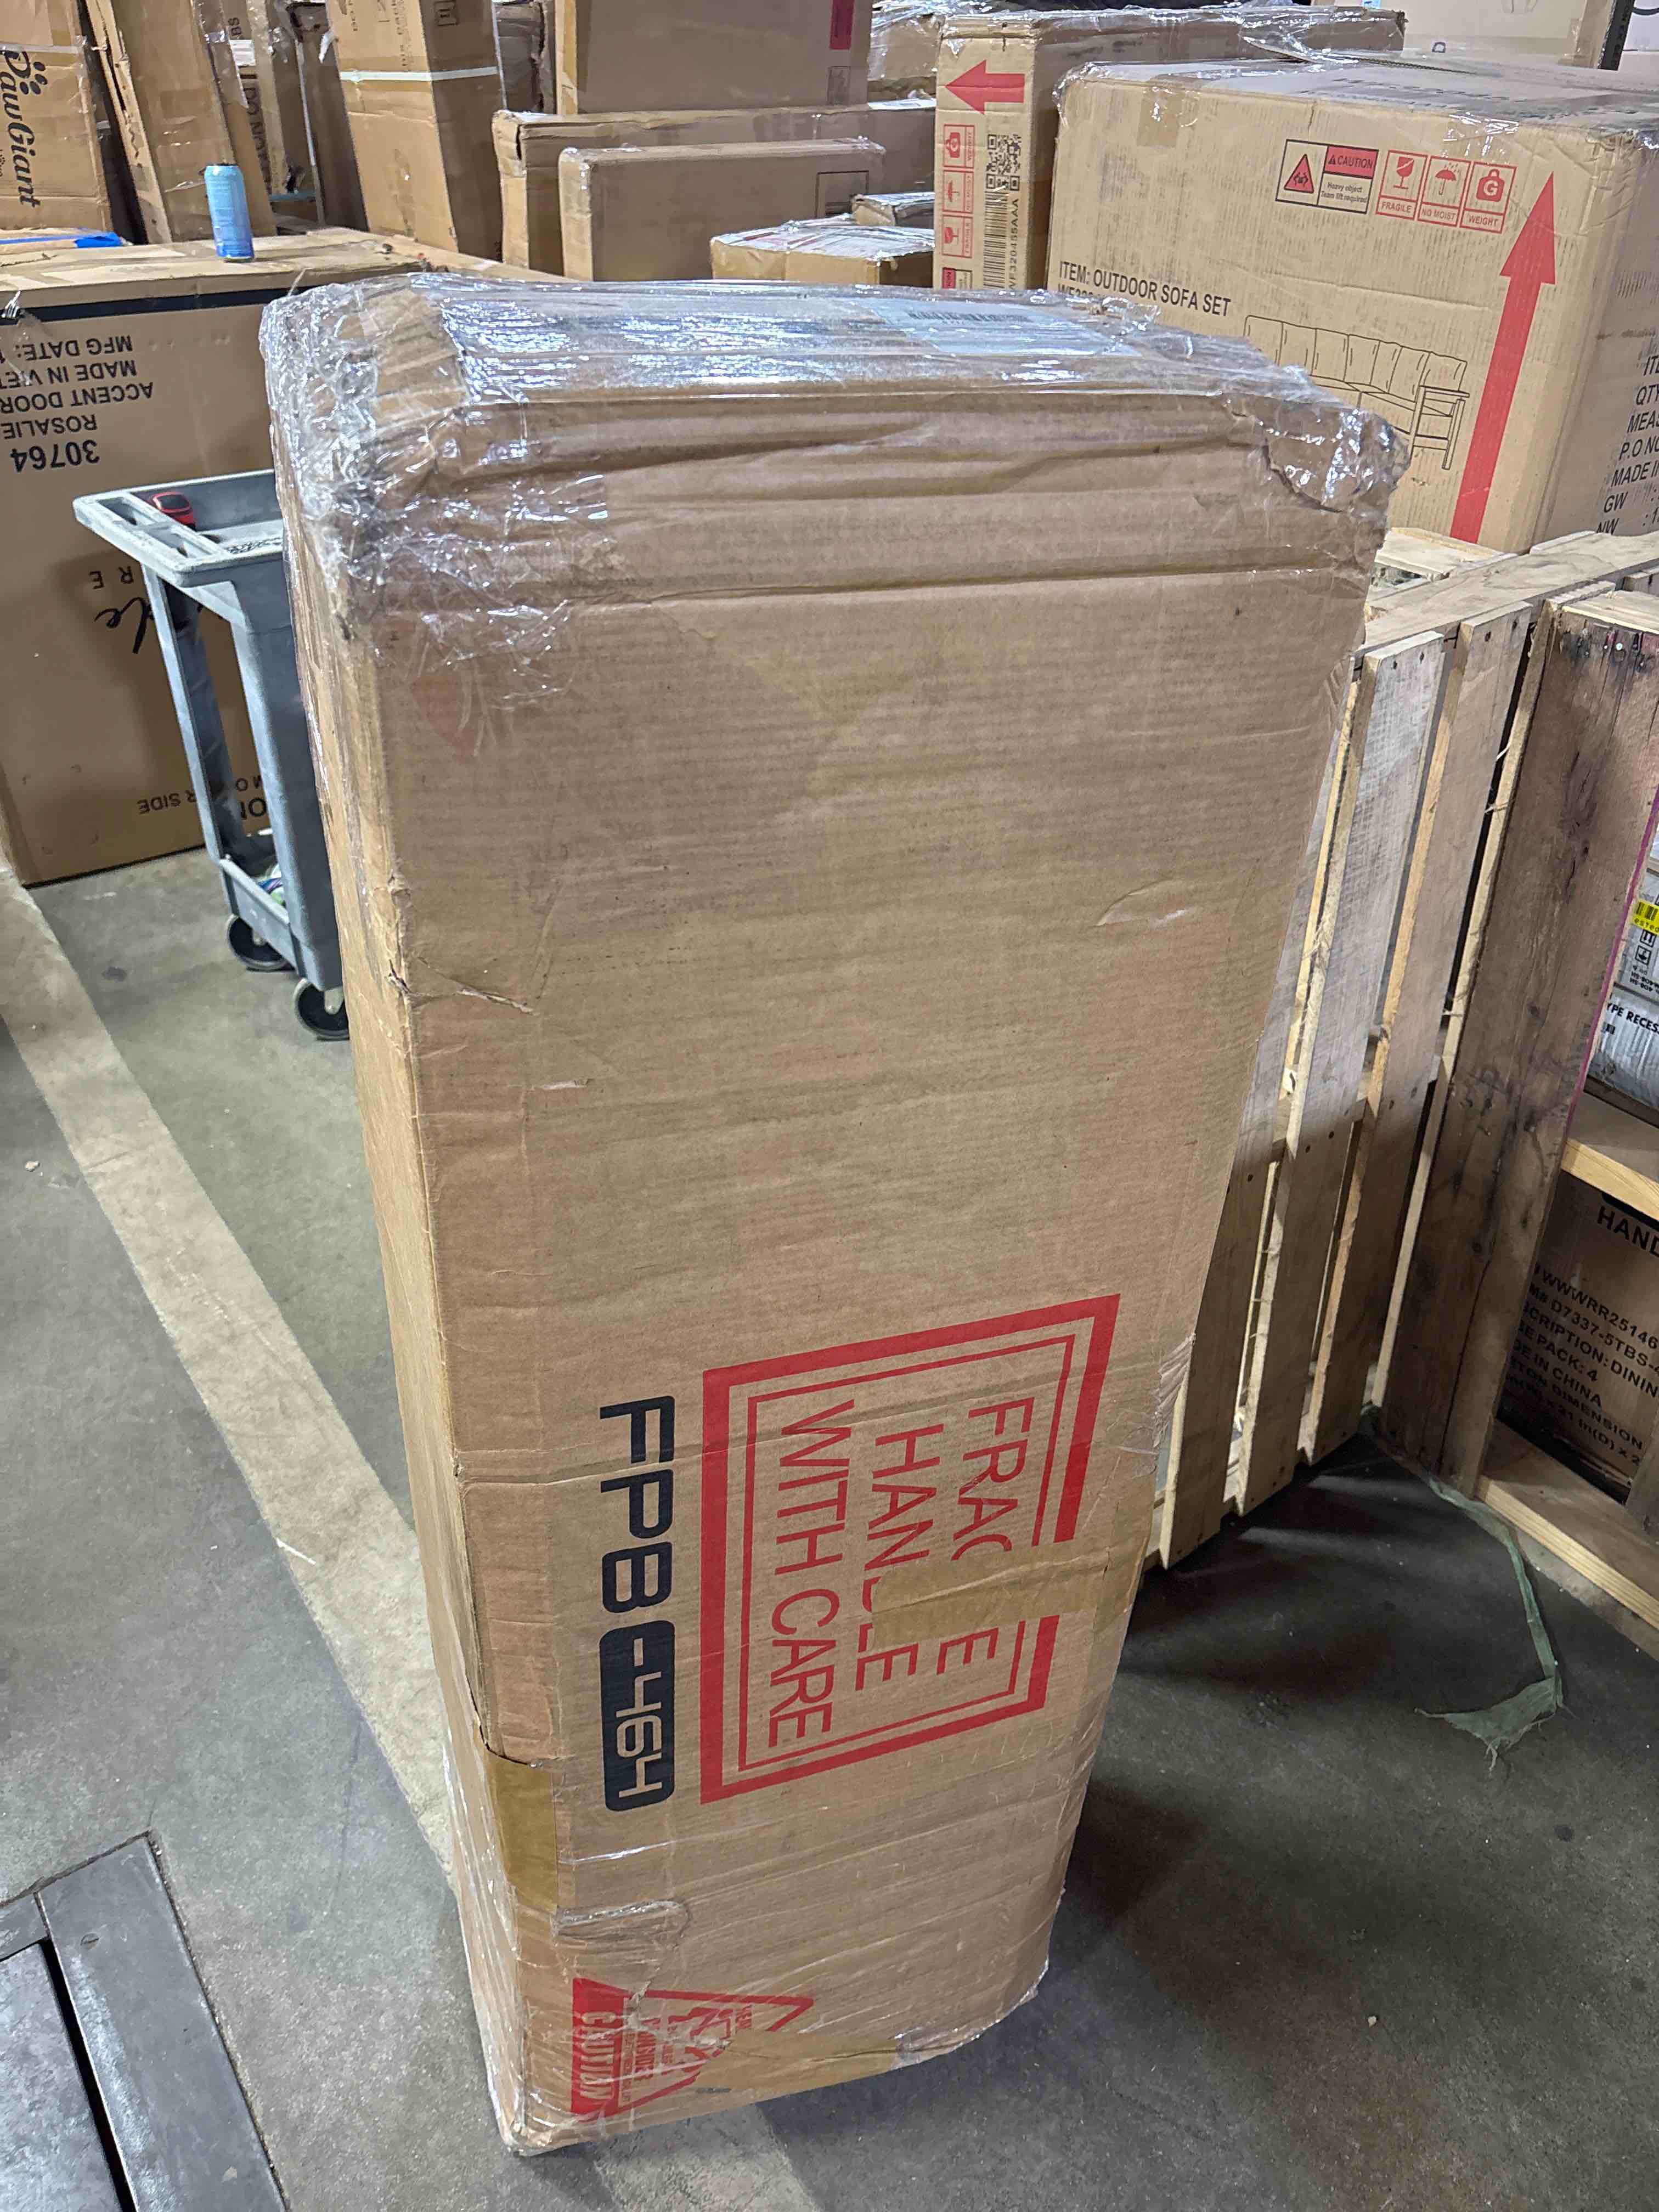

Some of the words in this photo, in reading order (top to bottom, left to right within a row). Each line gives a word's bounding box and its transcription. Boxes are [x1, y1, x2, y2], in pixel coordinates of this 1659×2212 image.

[0, 50, 40, 208] PawGiant
[1337, 155, 1373, 170] CAUTION
[1381, 201, 1413, 213] FRAGILE
[1421, 208, 1432, 217] NO
[1434, 210, 1457, 221] MOIST
[1468, 215, 1499, 227] WEIGHT
[1059, 261, 1090, 285] ITEM:
[1093, 269, 1158, 301] OUTDOOR
[1160, 285, 1198, 311] SOFA
[1202, 294, 1231, 317] SET
[15, 340, 80, 361] DATE:
[86, 335, 133, 356] MFG
[47, 366, 69, 385] IN
[75, 360, 137, 381] MADE
[0, 391, 64, 414] DOOR
[71, 381, 154, 407] ACCENT
[0, 414, 98, 439] ROSALIE
[10, 439, 100, 472] 30764
[1618, 439, 1643, 461] P.O
[1611, 462, 1650, 487] MADE
[1604, 492, 1628, 513] GW
[1596, 518, 1620, 534] NW
[137, 792, 180, 815] SIDE
[1607, 1003, 1624, 1017] YPE
[1626, 1011, 1659, 1035] RECES
[1537, 1334, 1585, 1374] PACK:
[1587, 1369, 1599, 1382] 4
[1552, 1367, 1602, 1408] CHINA
[1611, 1361, 1659, 1398] DININ
[775, 1398, 855, 1576] WITH
[936, 1397, 1035, 1675] FRAE
[855, 1423, 944, 1692] HANE
[768, 1588, 840, 1747] CARE
